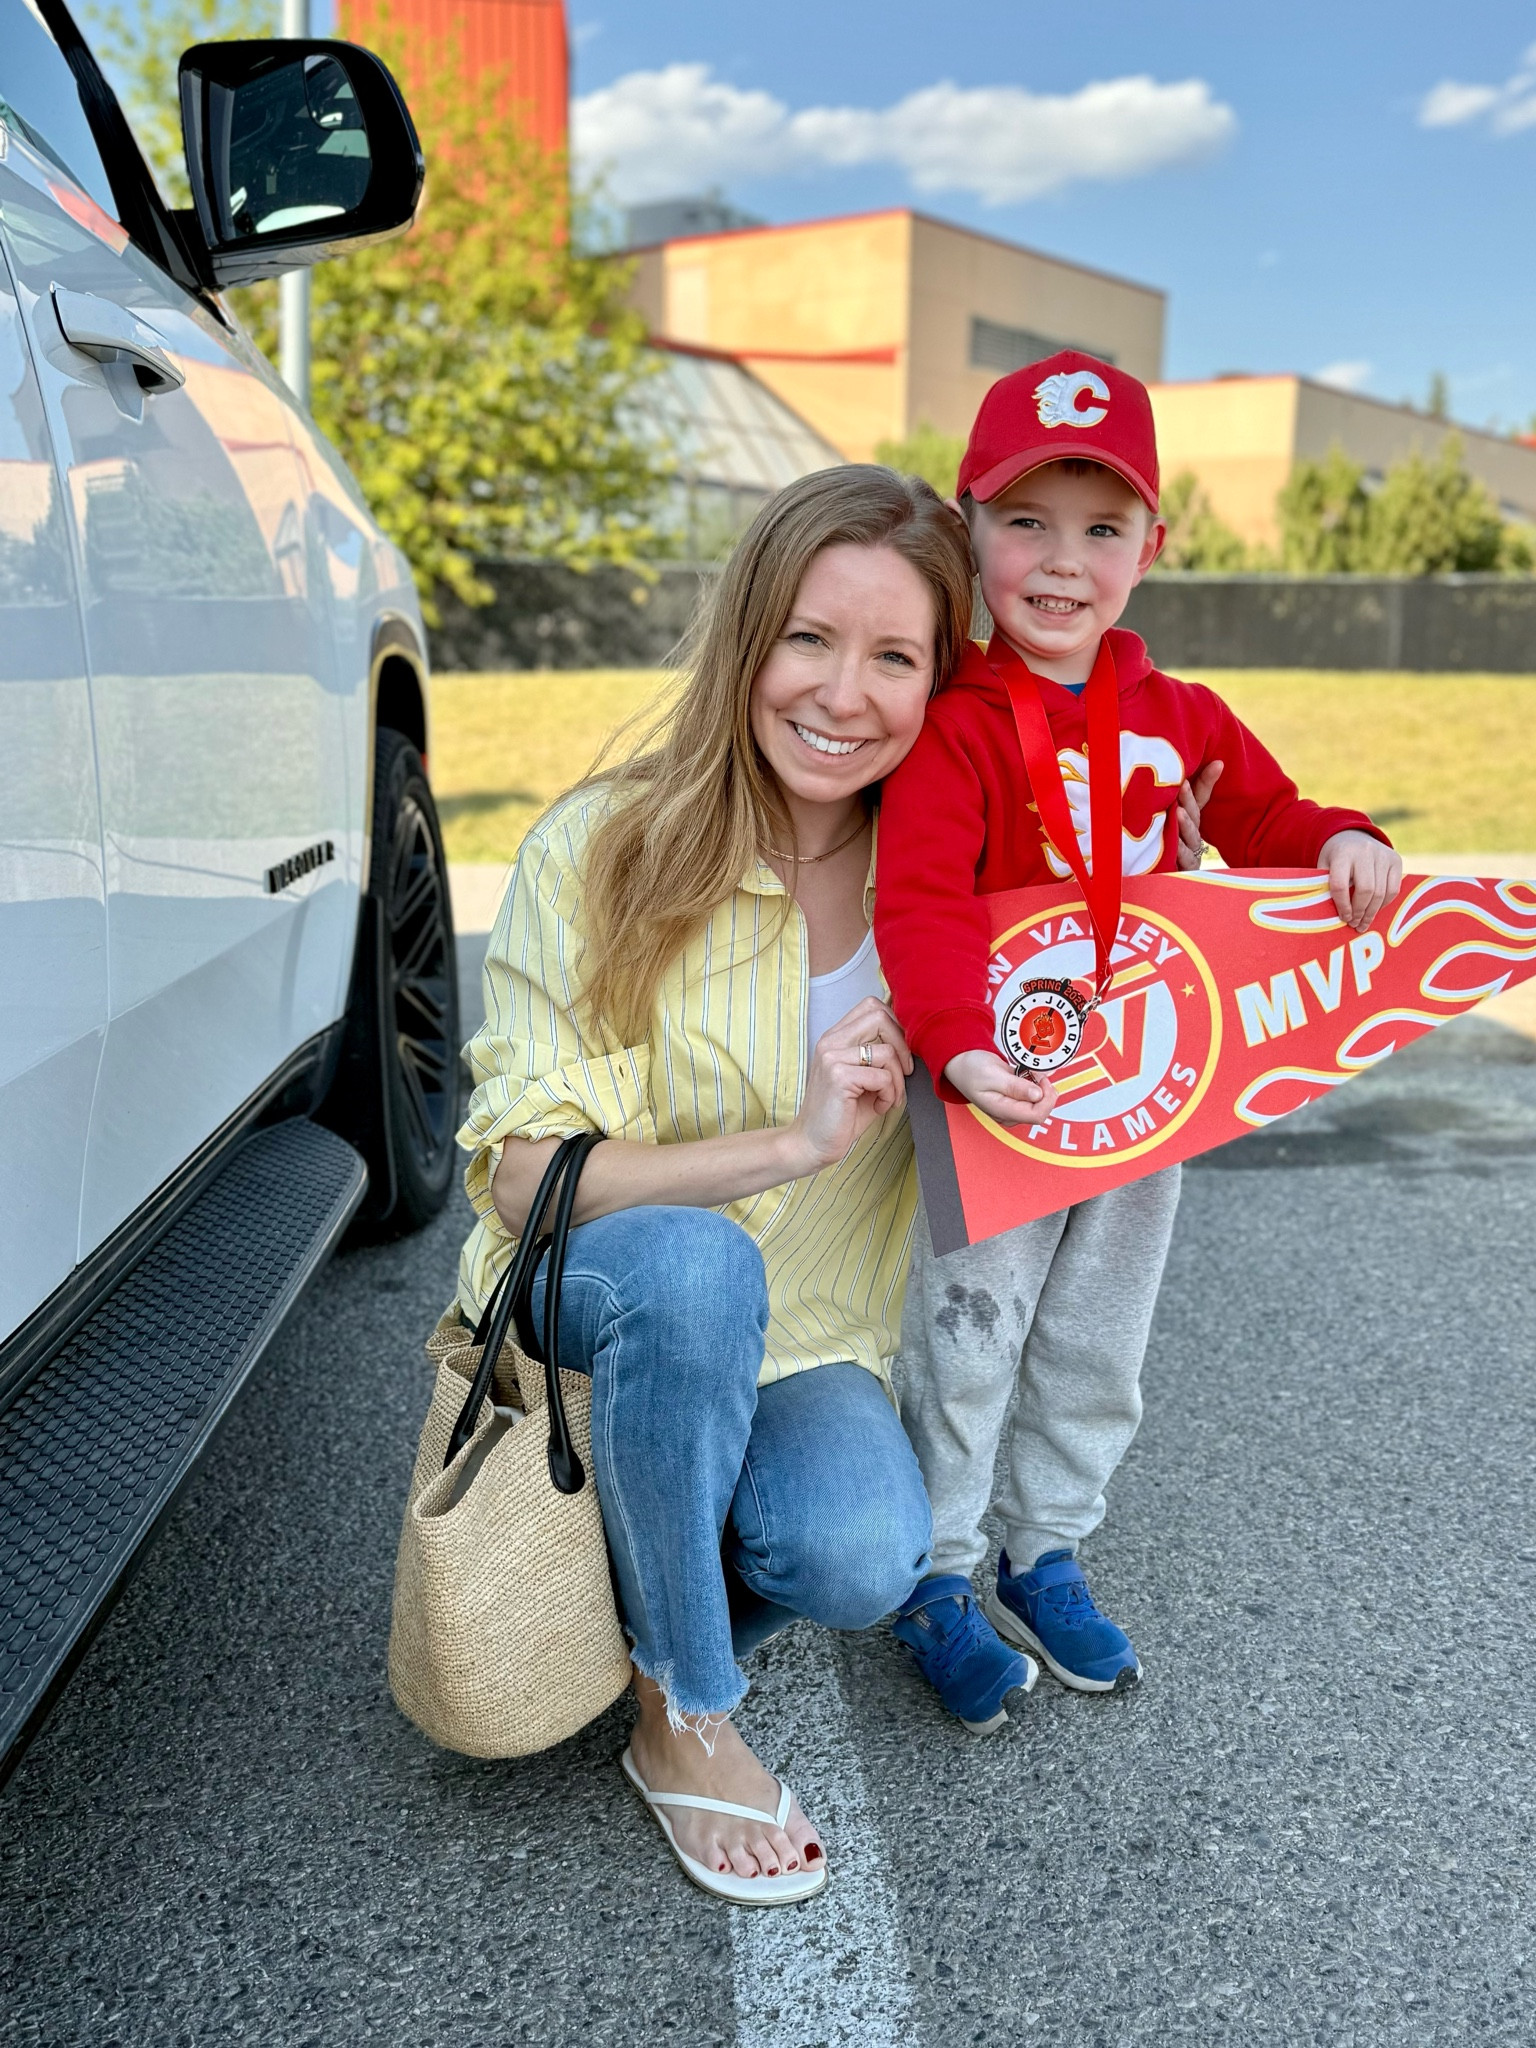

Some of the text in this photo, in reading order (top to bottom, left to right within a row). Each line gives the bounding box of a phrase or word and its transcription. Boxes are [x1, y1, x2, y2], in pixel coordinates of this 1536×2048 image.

[985, 952, 1013, 1004] W
[1023, 980, 1062, 993] SPRING
[1234, 930, 1385, 1049] MVP
[1008, 1004, 1040, 1067] FLAMES
[1045, 995, 1077, 1055] JUNIOR
[1028, 1062, 1197, 1151] FLAMES
